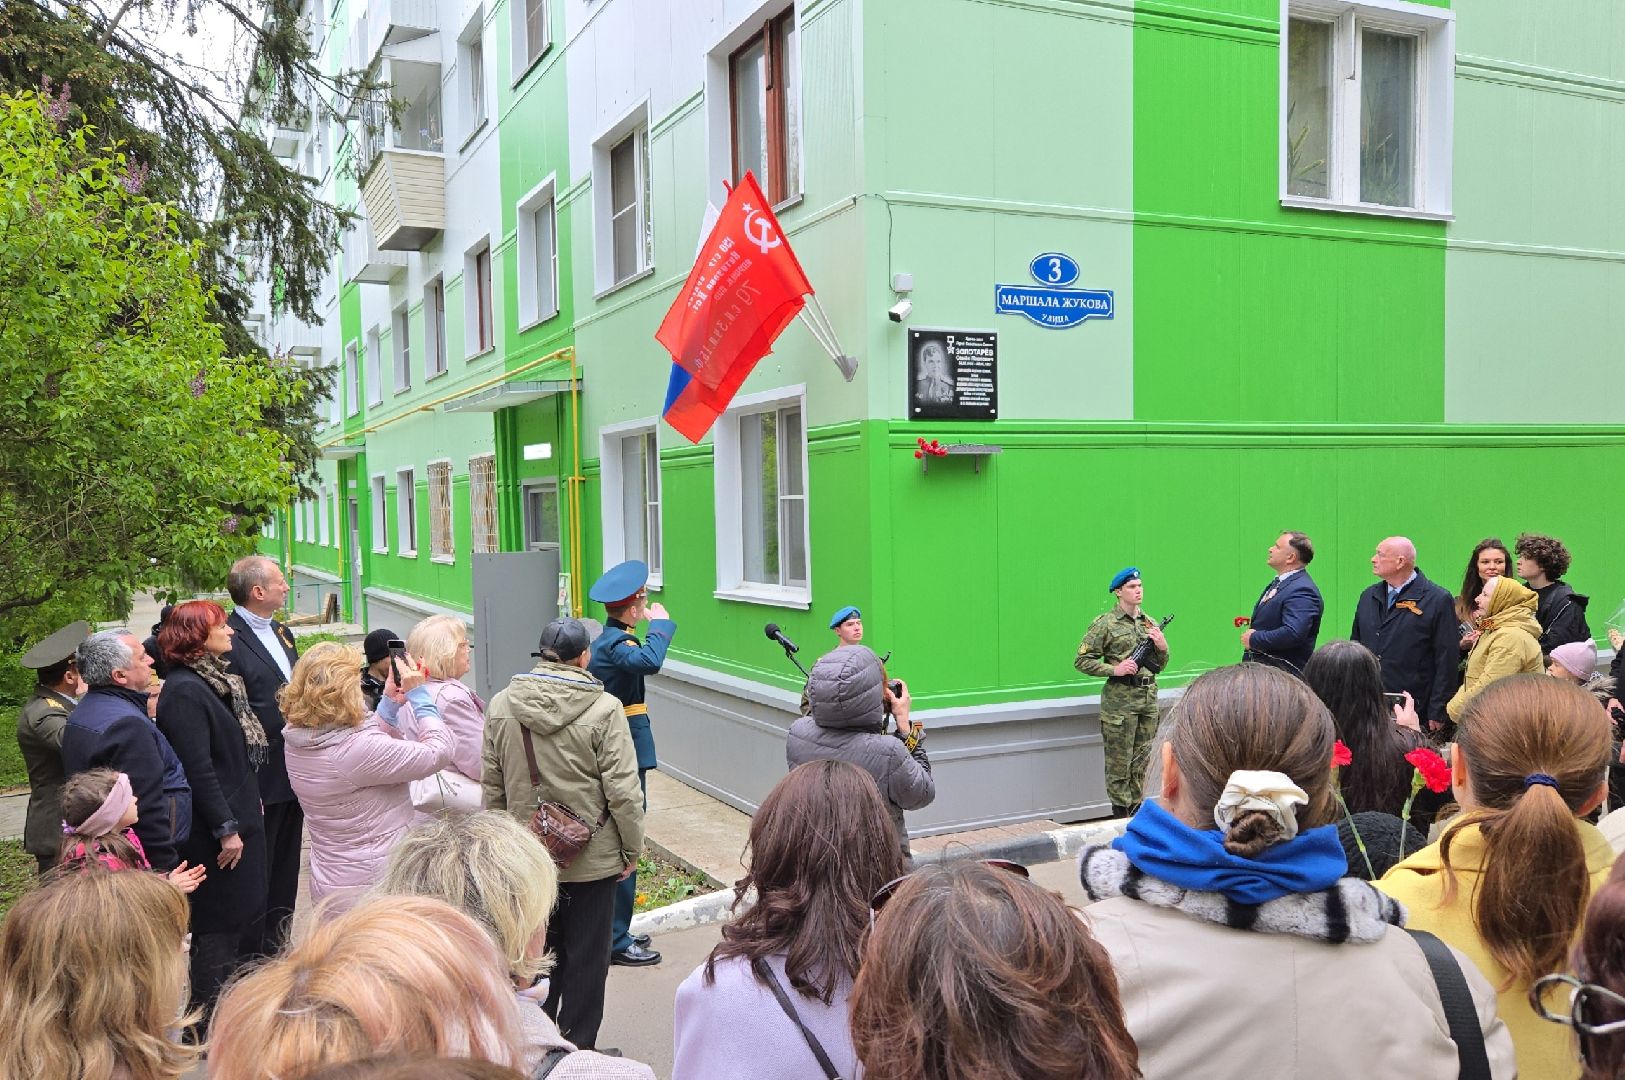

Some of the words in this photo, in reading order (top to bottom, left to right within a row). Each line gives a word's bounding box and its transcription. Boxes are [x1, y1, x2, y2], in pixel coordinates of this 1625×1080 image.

[1048, 258, 1062, 282] 3
[1001, 294, 1061, 308] МАРШАЛА
[1062, 297, 1108, 310] ЖУКОВА
[1041, 313, 1070, 325] УЛИЦА
